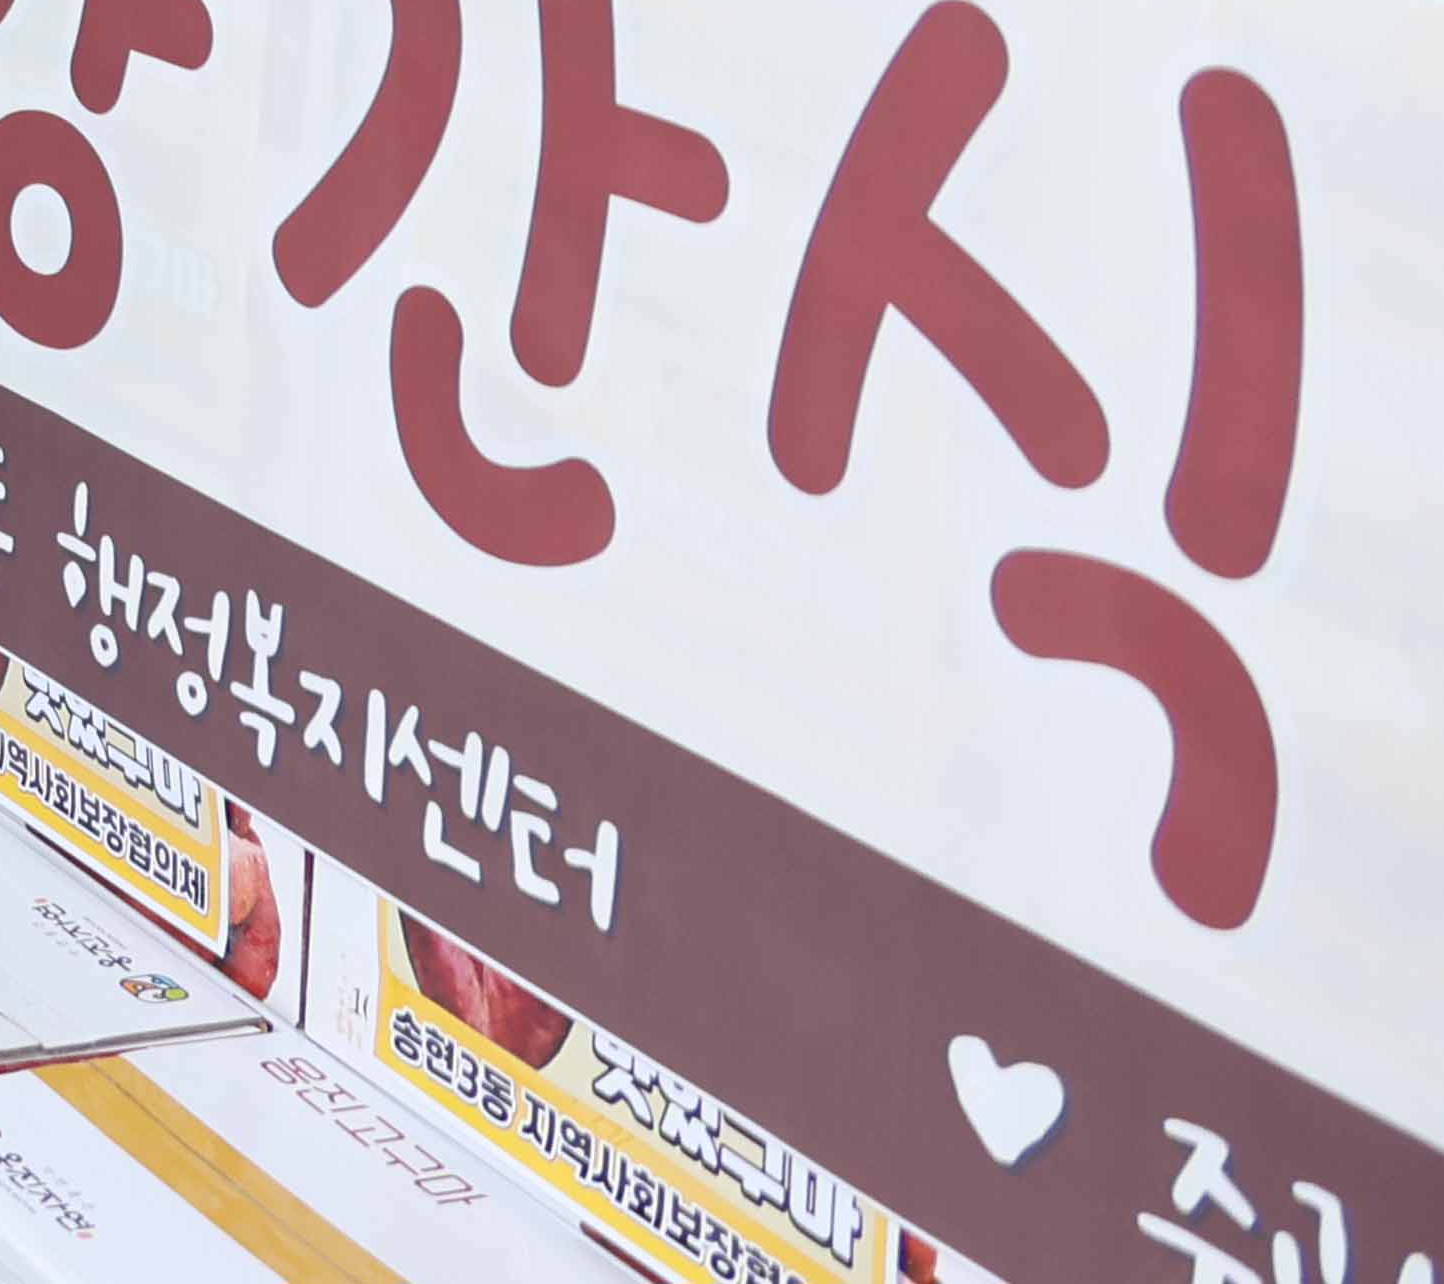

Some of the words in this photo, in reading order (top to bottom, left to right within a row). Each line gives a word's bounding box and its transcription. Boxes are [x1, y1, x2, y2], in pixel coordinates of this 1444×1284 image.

[56, 483, 620, 933] 행정복지센터
[259, 1055, 490, 1212] 옹진고구마
[391, 1010, 516, 1126] 송현3동
